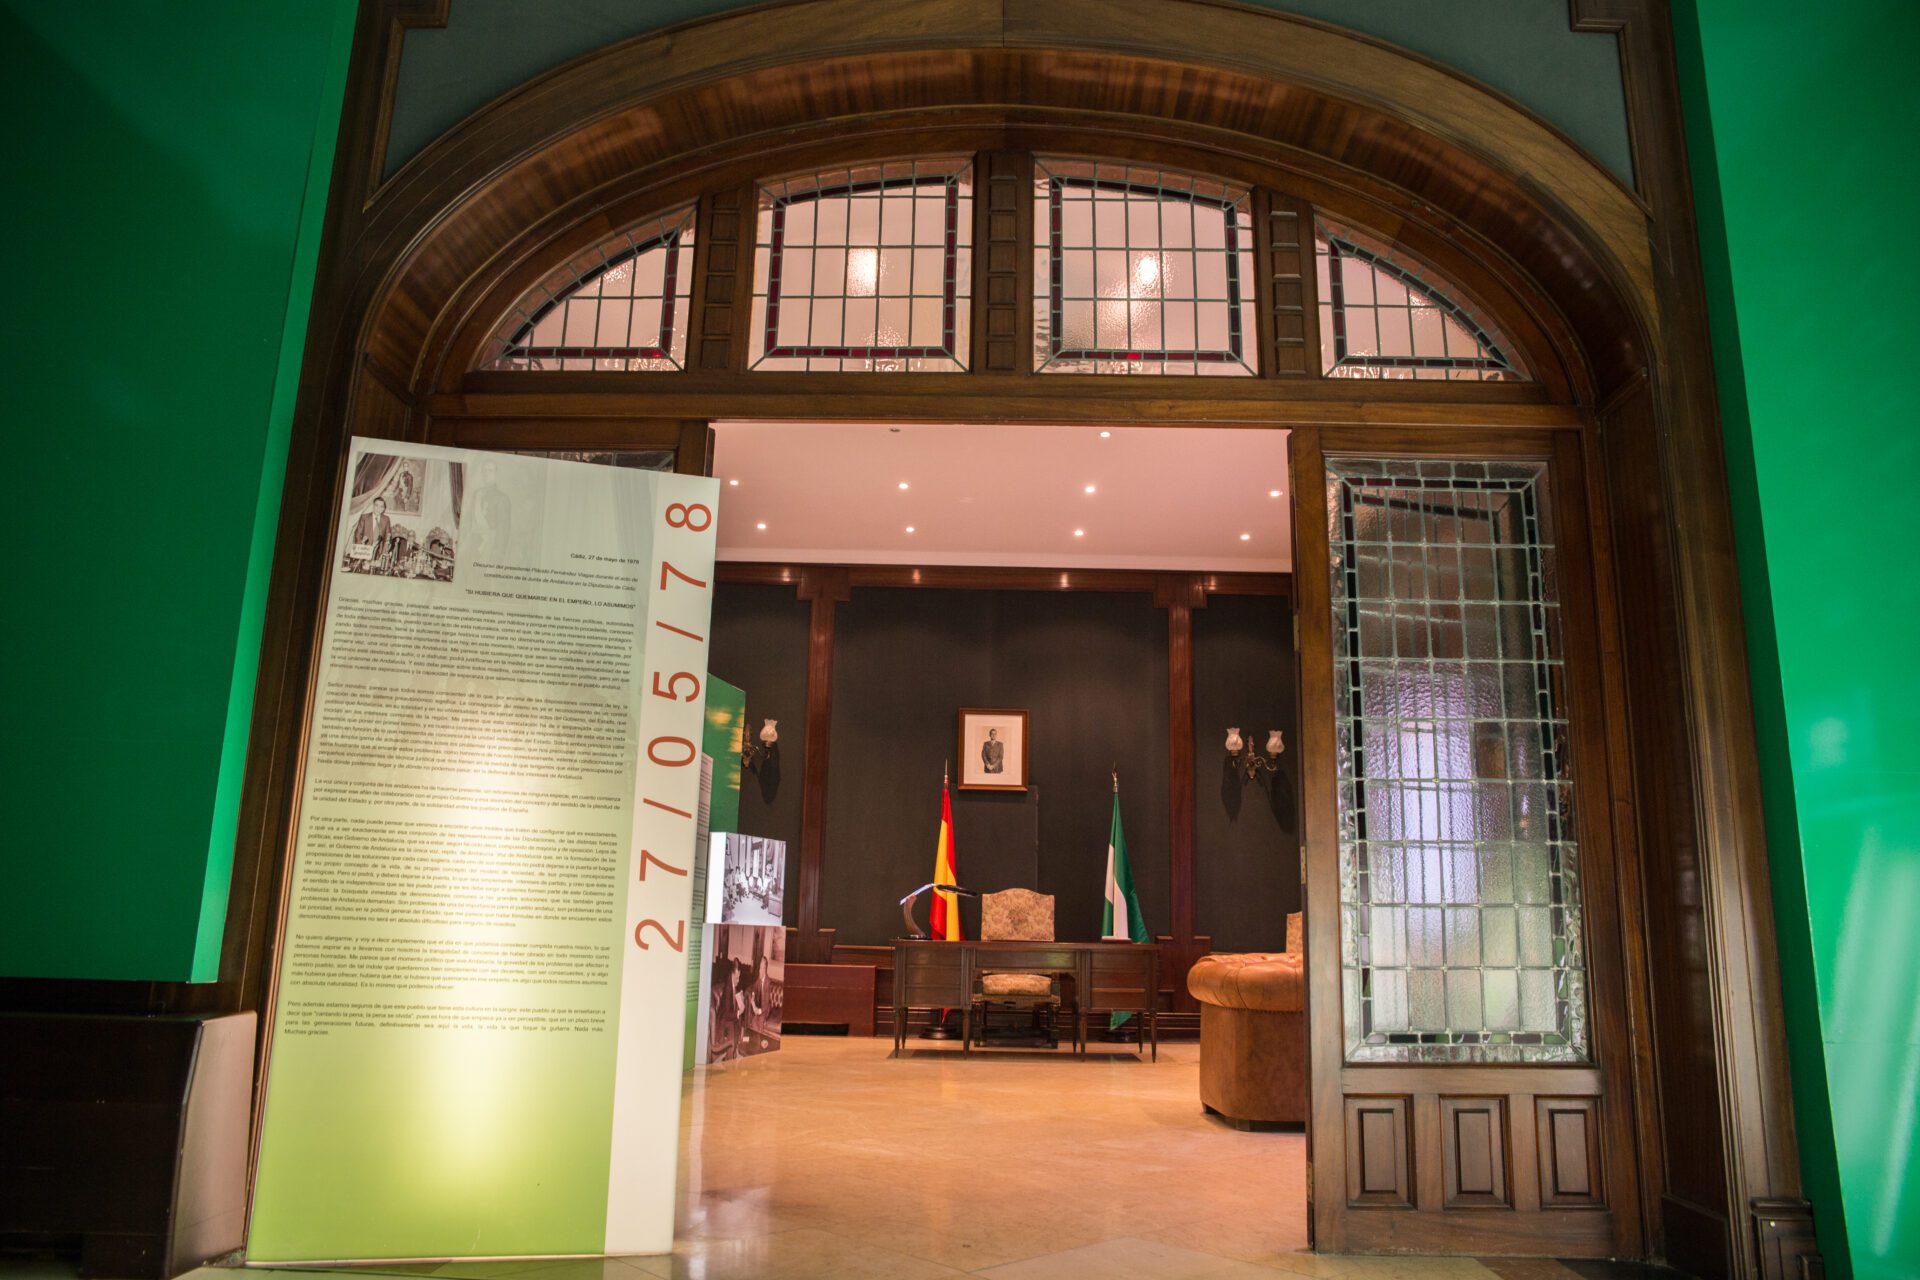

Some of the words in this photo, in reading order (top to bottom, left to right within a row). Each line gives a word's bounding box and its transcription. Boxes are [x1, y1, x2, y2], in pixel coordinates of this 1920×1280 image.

[570, 552, 587, 560] Cádiz,
[503, 564, 530, 573] presidente
[586, 581, 613, 589] Diputación
[514, 593, 548, 602] QUEMARSE
[603, 601, 636, 609] ASUMIMOS"
[636, 503, 712, 952] 27/05/78
